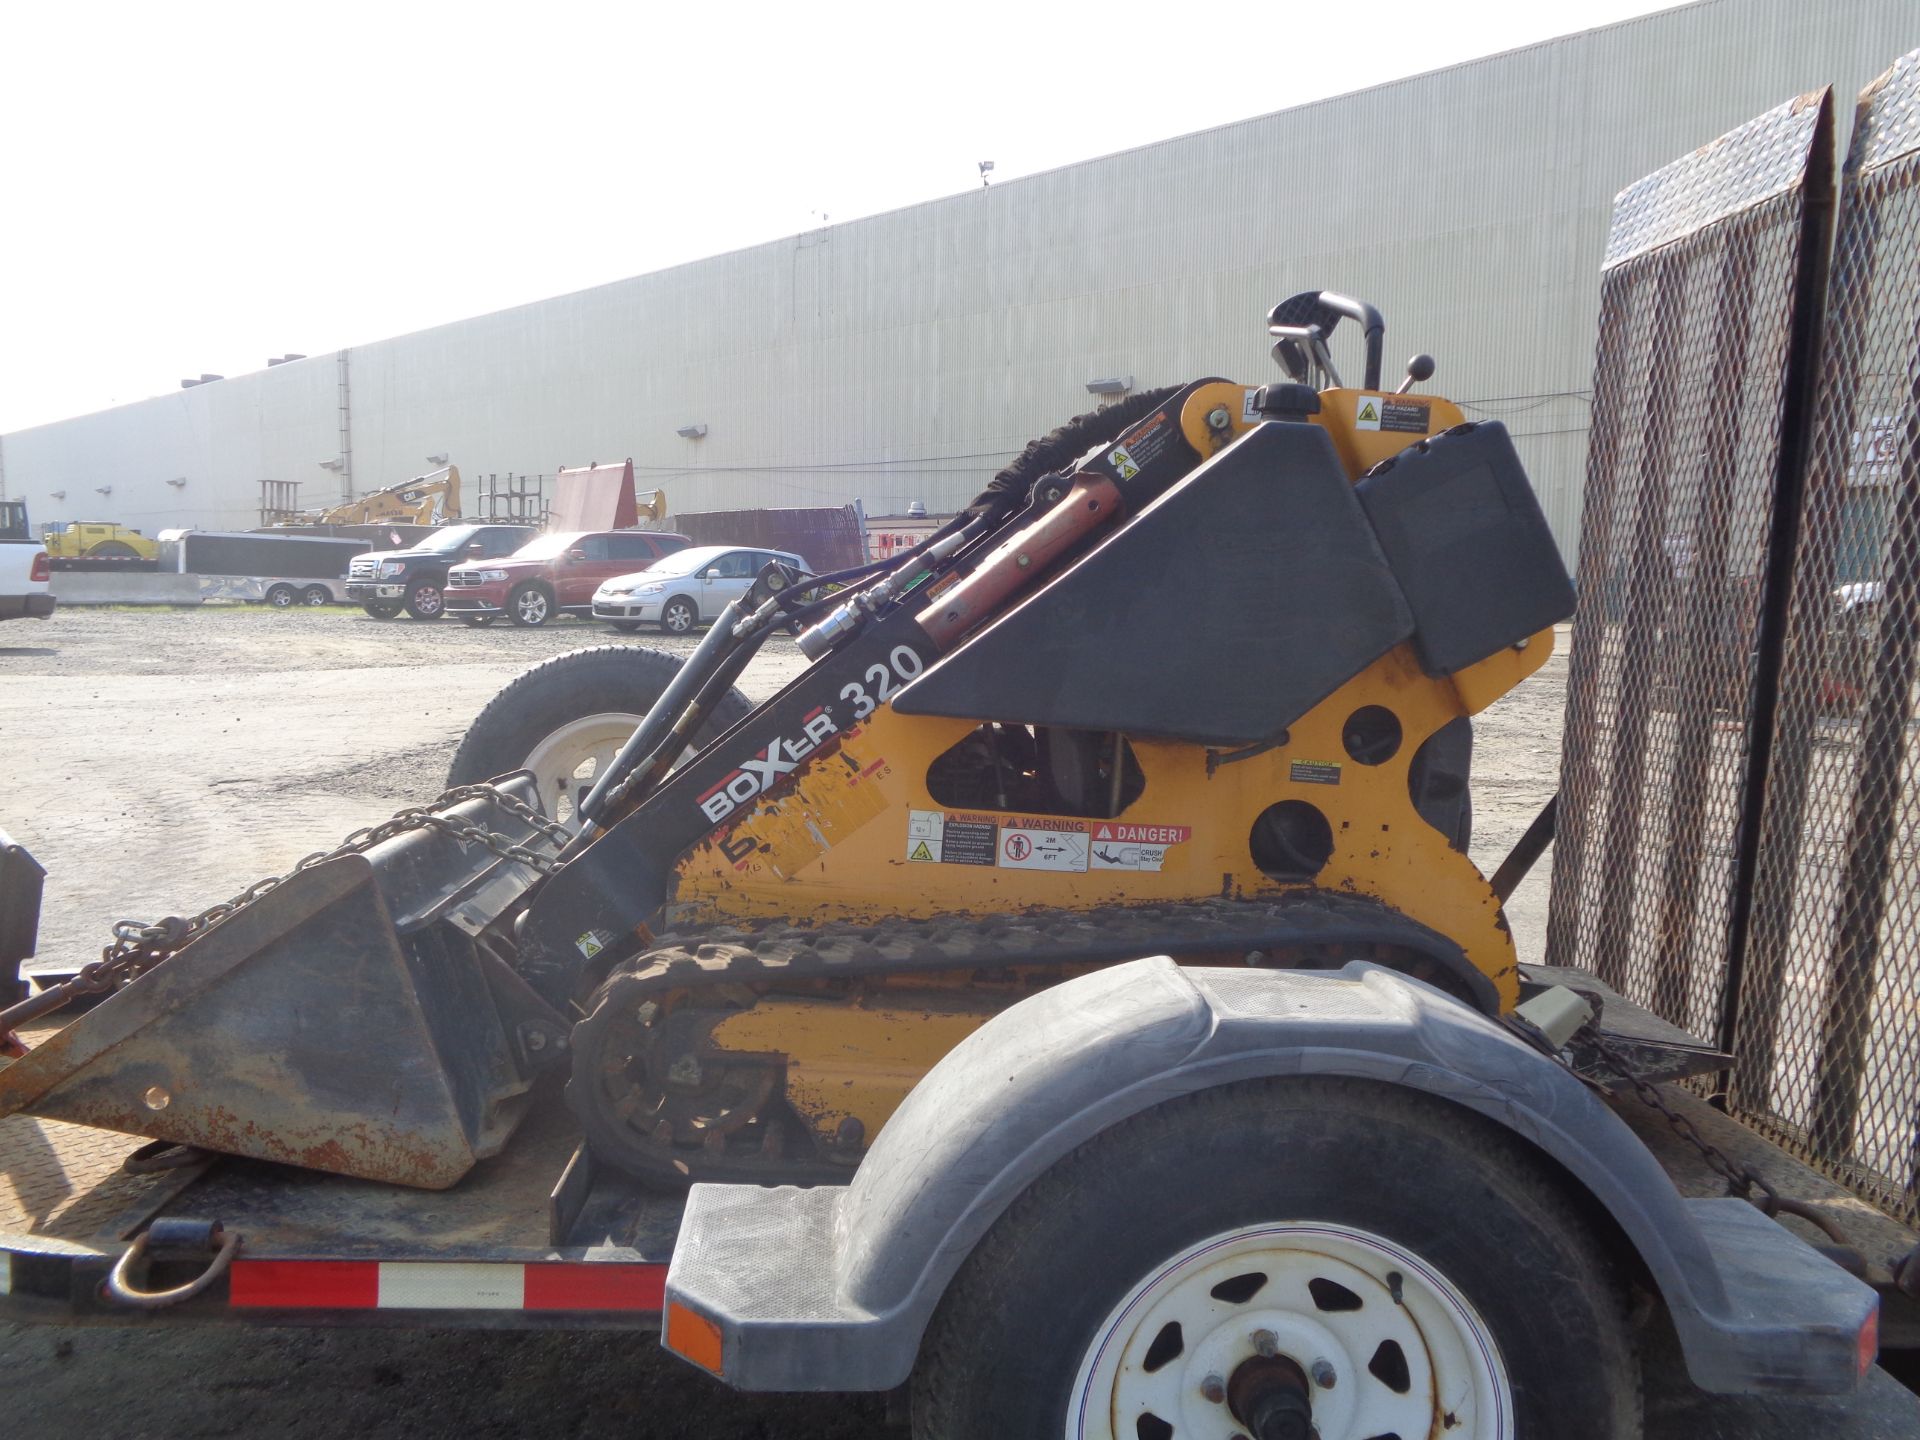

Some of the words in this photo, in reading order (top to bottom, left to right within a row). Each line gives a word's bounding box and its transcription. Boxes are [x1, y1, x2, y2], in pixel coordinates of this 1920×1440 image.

[403, 492, 416, 502] CAT
[840, 645, 924, 719] 320
[959, 813, 996, 824] WARNING
[1022, 818, 1085, 832] WARNING
[1117, 826, 1183, 842] DANGER!
[1141, 848, 1163, 857] CRUSH
